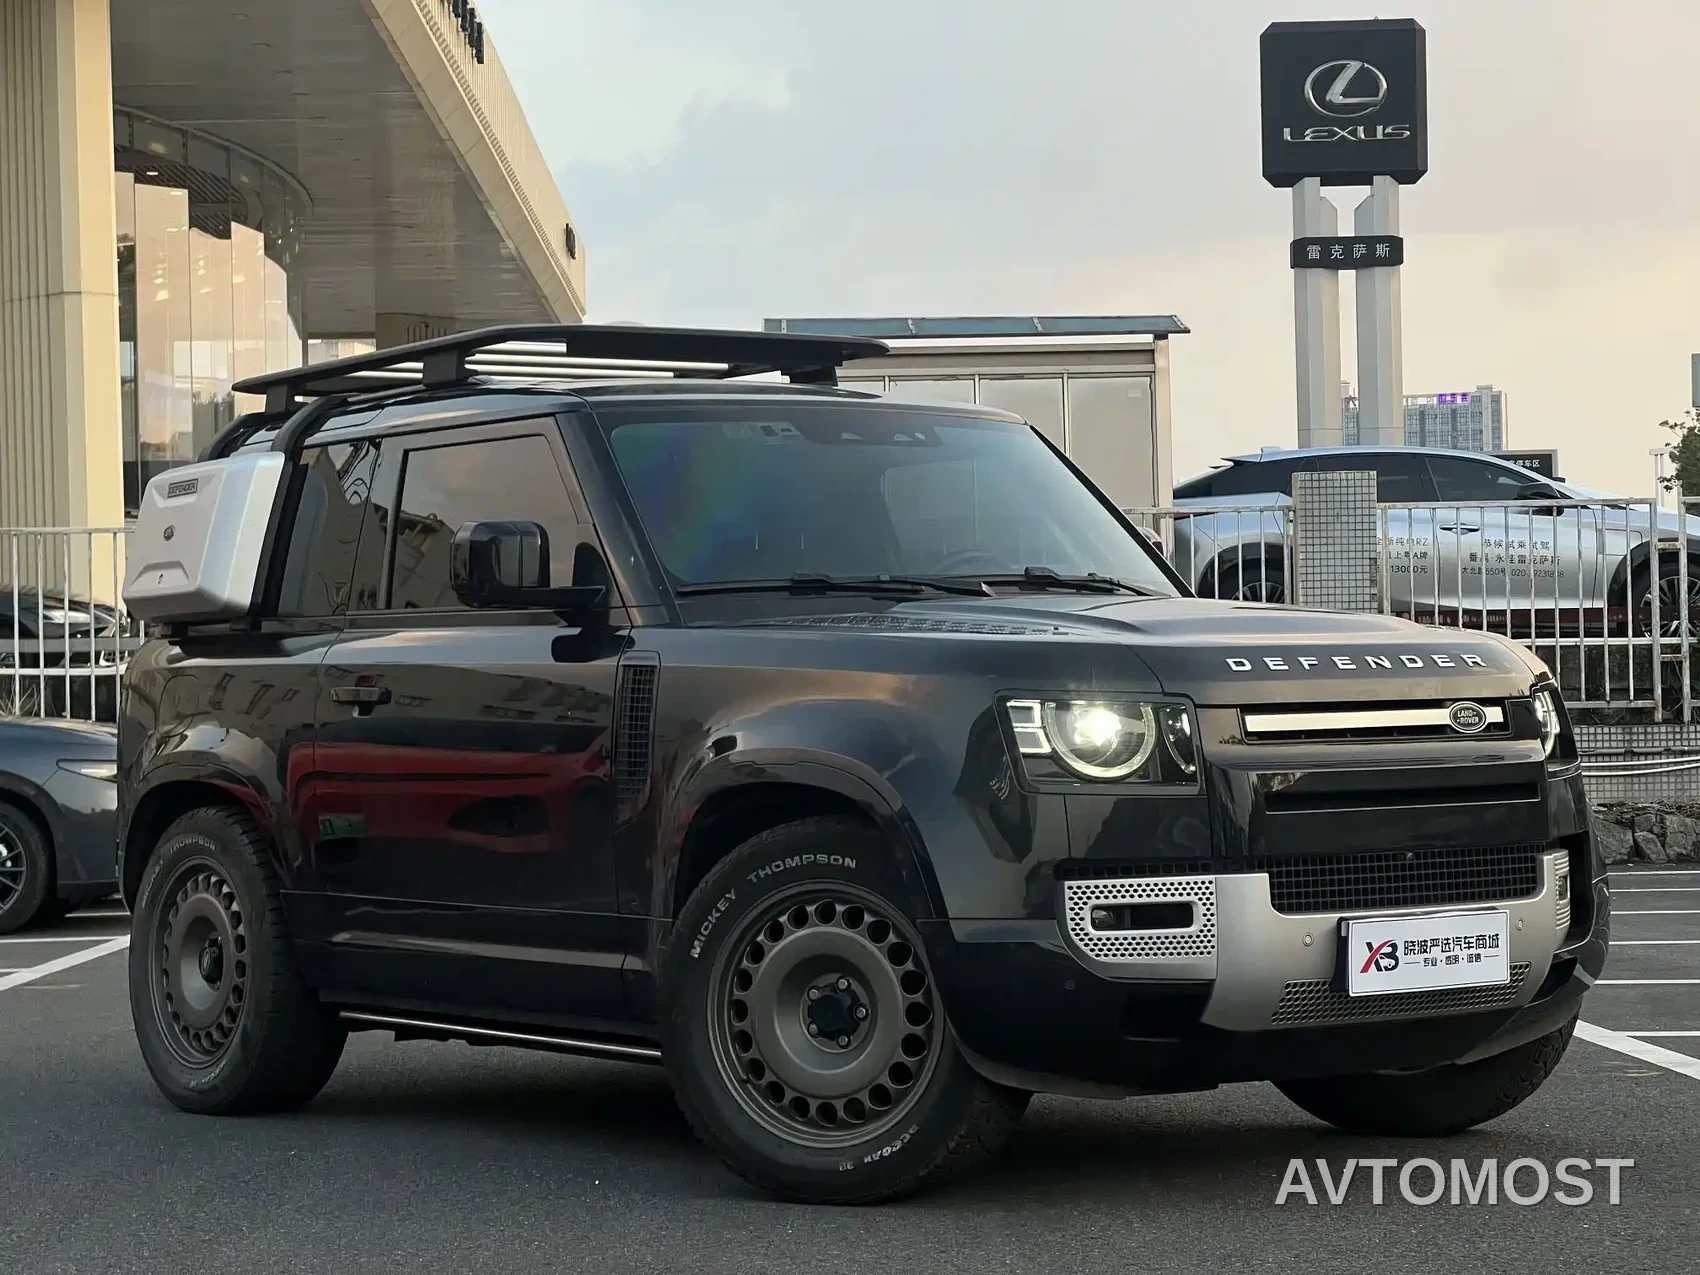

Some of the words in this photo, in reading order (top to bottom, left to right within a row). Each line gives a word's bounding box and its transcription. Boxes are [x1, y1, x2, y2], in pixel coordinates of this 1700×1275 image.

[1283, 124, 1410, 142] LEXUS
[1307, 244, 1390, 260] 雷克萨斯
[1225, 653, 1487, 672] DEFENDER
[689, 888, 738, 959] MICKEY
[746, 854, 857, 884] THOMPSON
[1404, 933, 1500, 956] 晓波严选汽车商城
